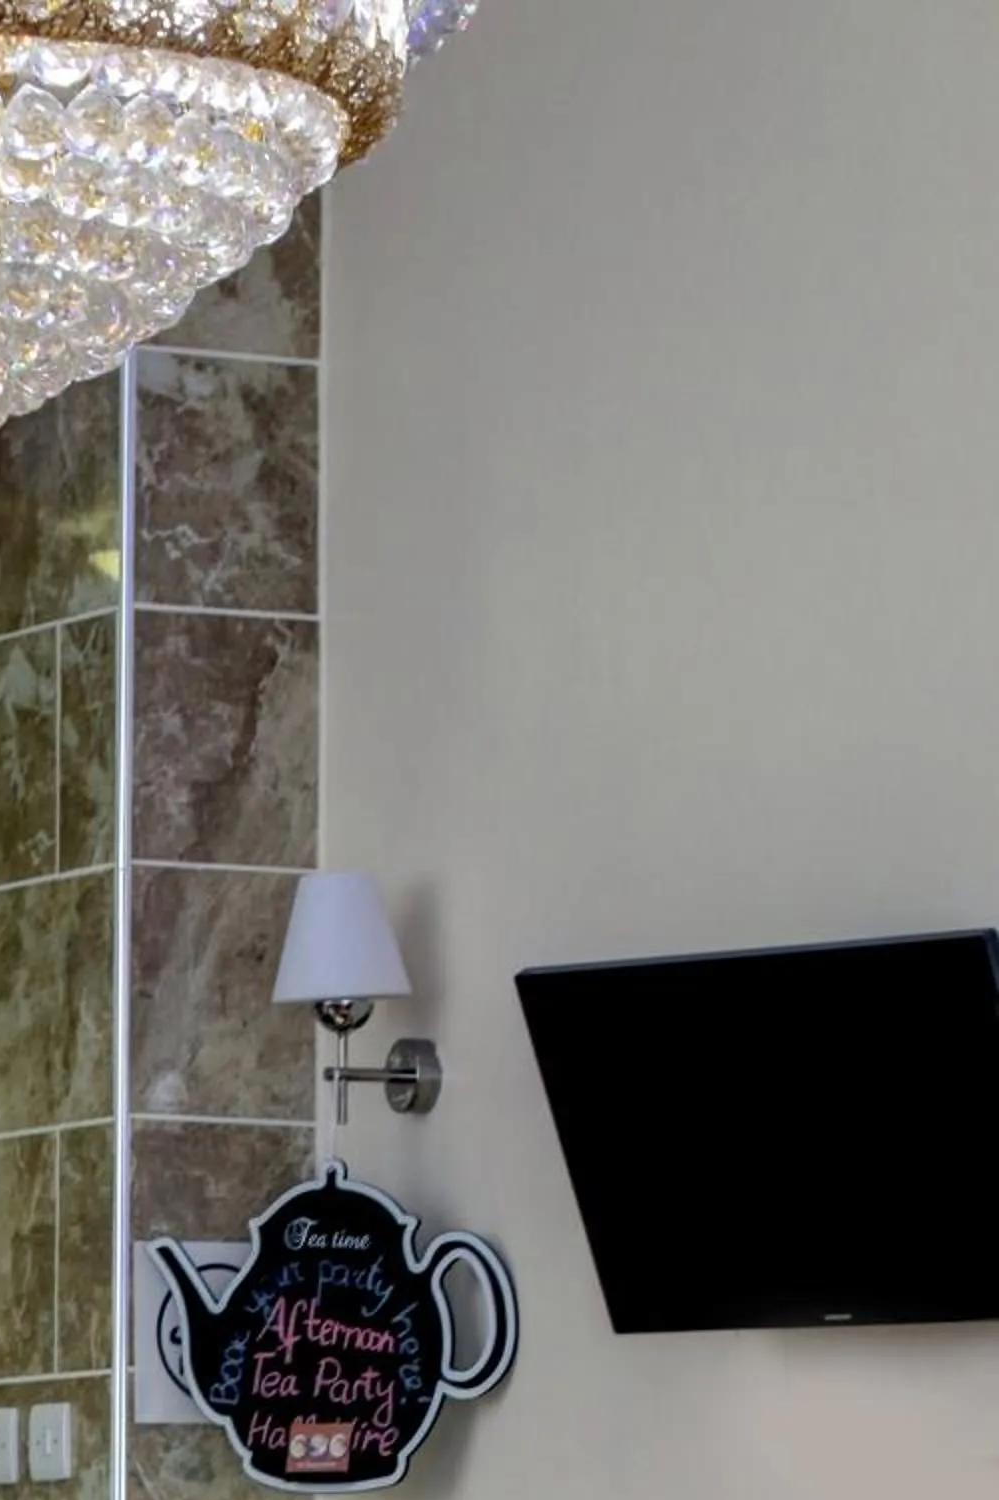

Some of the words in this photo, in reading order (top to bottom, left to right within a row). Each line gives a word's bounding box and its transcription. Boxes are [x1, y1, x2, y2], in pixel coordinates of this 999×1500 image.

[283, 1215, 328, 1251] Tea
[331, 1229, 372, 1250] time
[316, 1253, 396, 1318] party
[256, 1294, 396, 1365] Afternoon
[252, 1352, 301, 1399] Tea
[314, 1356, 396, 1428] Party
